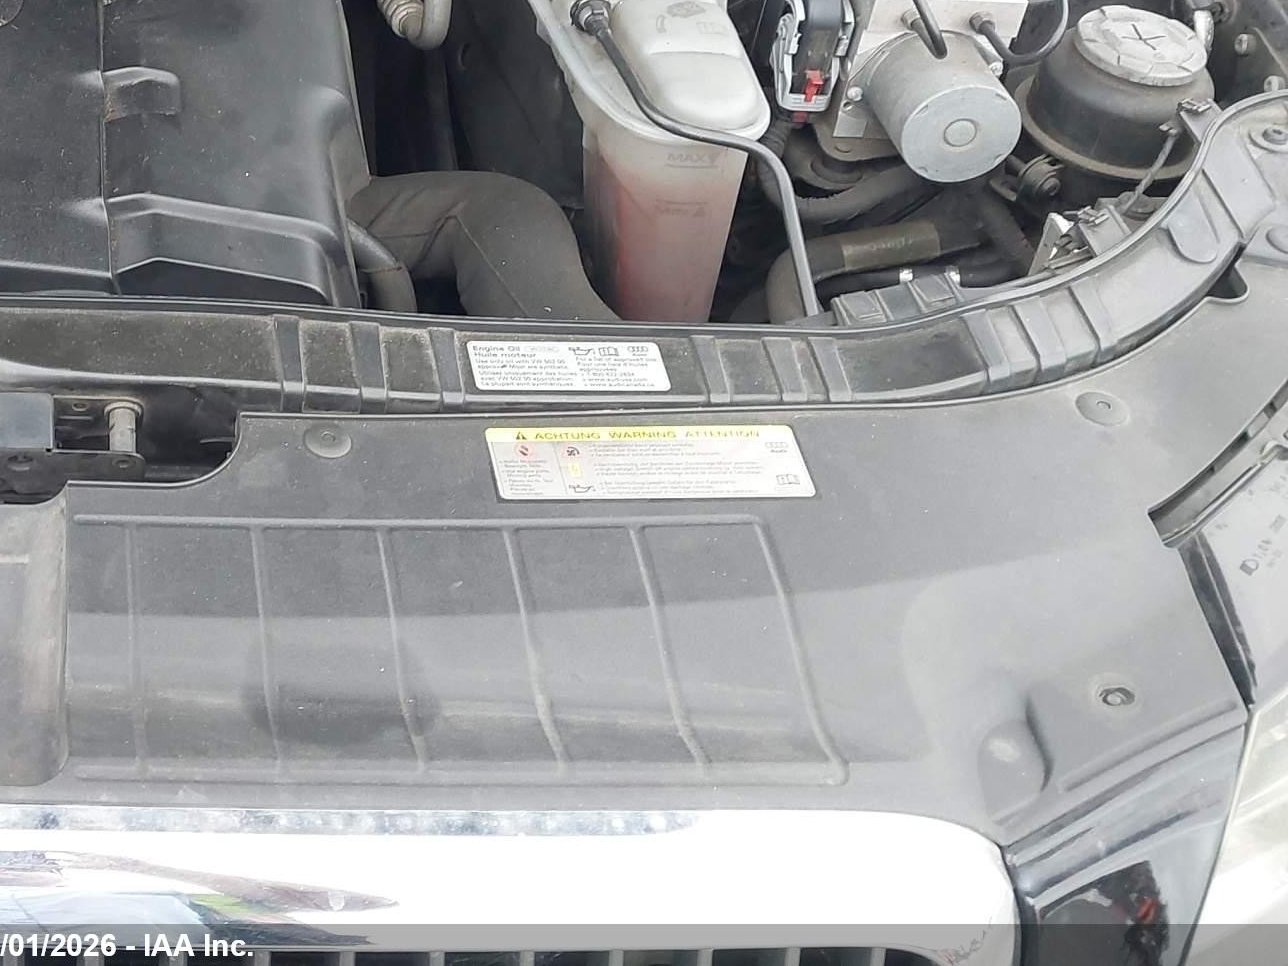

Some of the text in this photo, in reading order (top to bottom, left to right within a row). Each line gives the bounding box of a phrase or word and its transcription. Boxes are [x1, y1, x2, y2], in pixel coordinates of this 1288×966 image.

[472, 345, 505, 353] Engine
[534, 430, 761, 440] ACHTUNG WARNING ATTENTION
